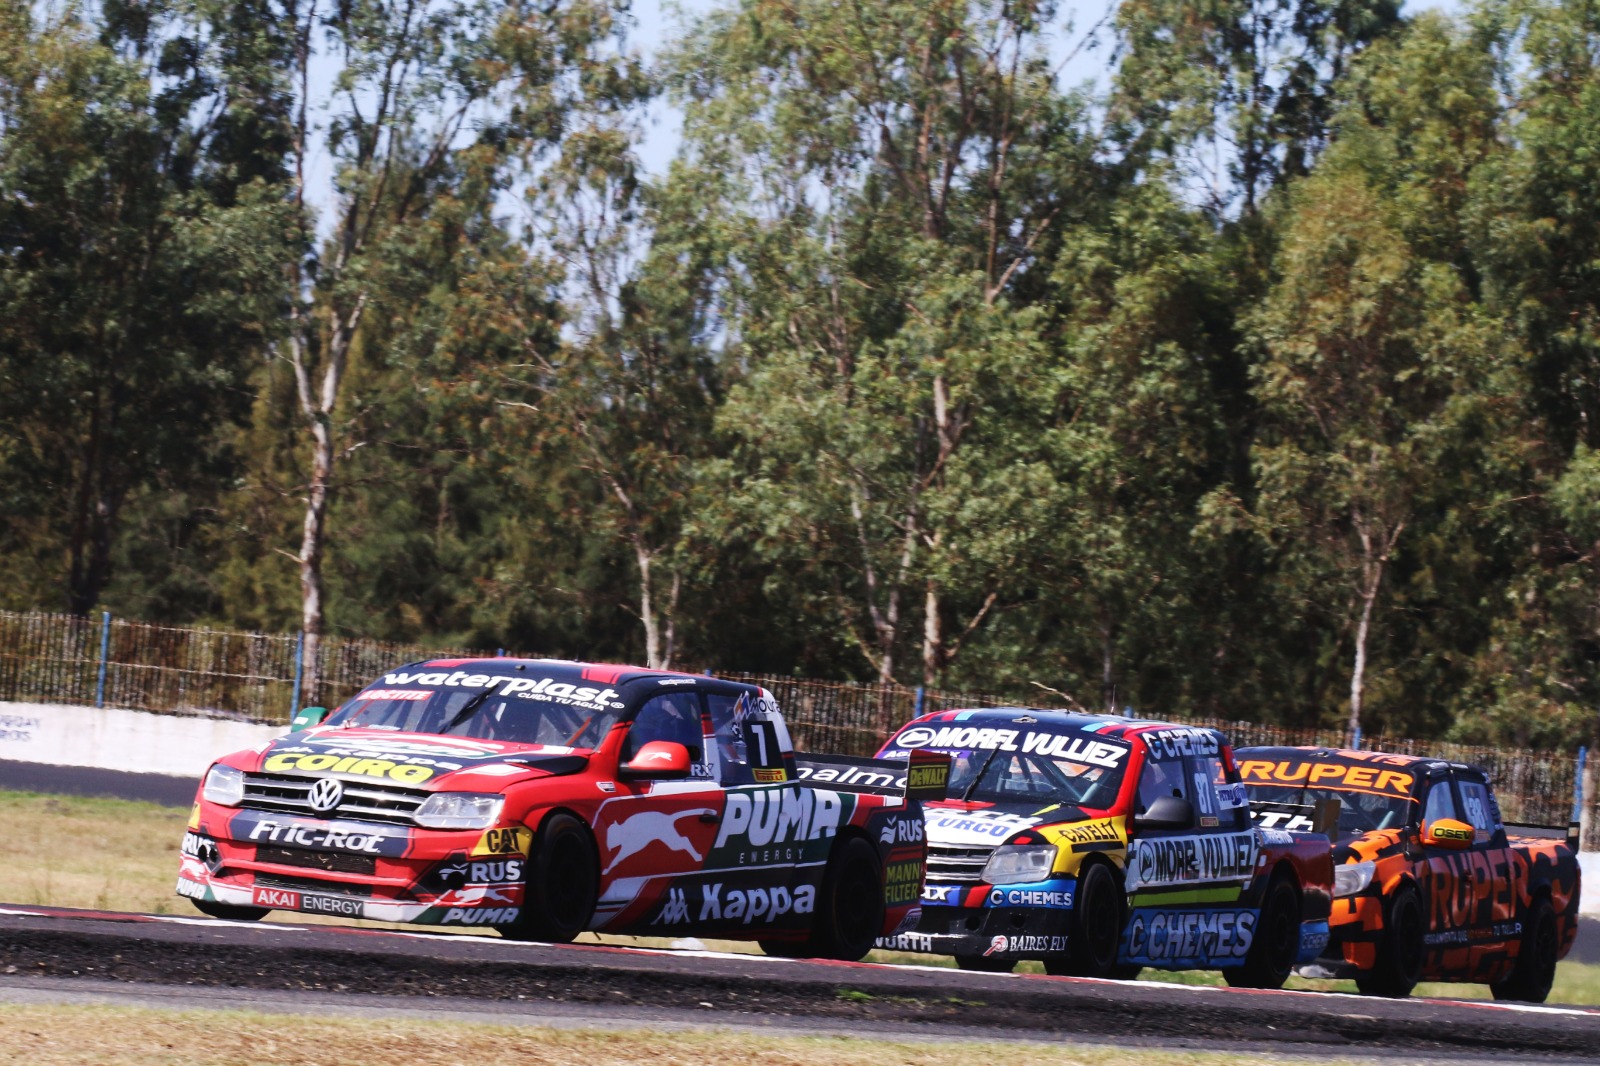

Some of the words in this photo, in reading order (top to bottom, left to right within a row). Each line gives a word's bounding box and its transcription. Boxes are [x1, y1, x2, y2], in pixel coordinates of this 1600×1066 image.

[384, 671, 619, 706] waterplast
[517, 692, 552, 702] CUIDA
[555, 697, 573, 705] TU
[571, 700, 604, 711] AGUA
[751, 724, 768, 767] 1
[930, 727, 1020, 751] MOREL
[1021, 732, 1128, 769] VULLIEZ
[264, 753, 434, 784] COIRO
[714, 787, 842, 849] PUMA
[487, 828, 520, 853] CAT
[898, 820, 923, 842] RUS
[739, 848, 804, 864] ENERGY
[471, 860, 521, 882] RUS
[886, 862, 921, 883] MANN
[257, 889, 295, 907] AKAI
[303, 896, 362, 914] ENERGY
[699, 883, 816, 925] Kappa
[885, 883, 918, 904] FILTER
[990, 890, 1004, 905] C
[1008, 890, 1072, 906] CHEMES
[440, 908, 520, 924] PUMA
[1009, 935, 1049, 952] BAIRES
[1050, 936, 1068, 951] FLY
[1130, 918, 1144, 957] C
[1151, 912, 1255, 958] CHEMES
